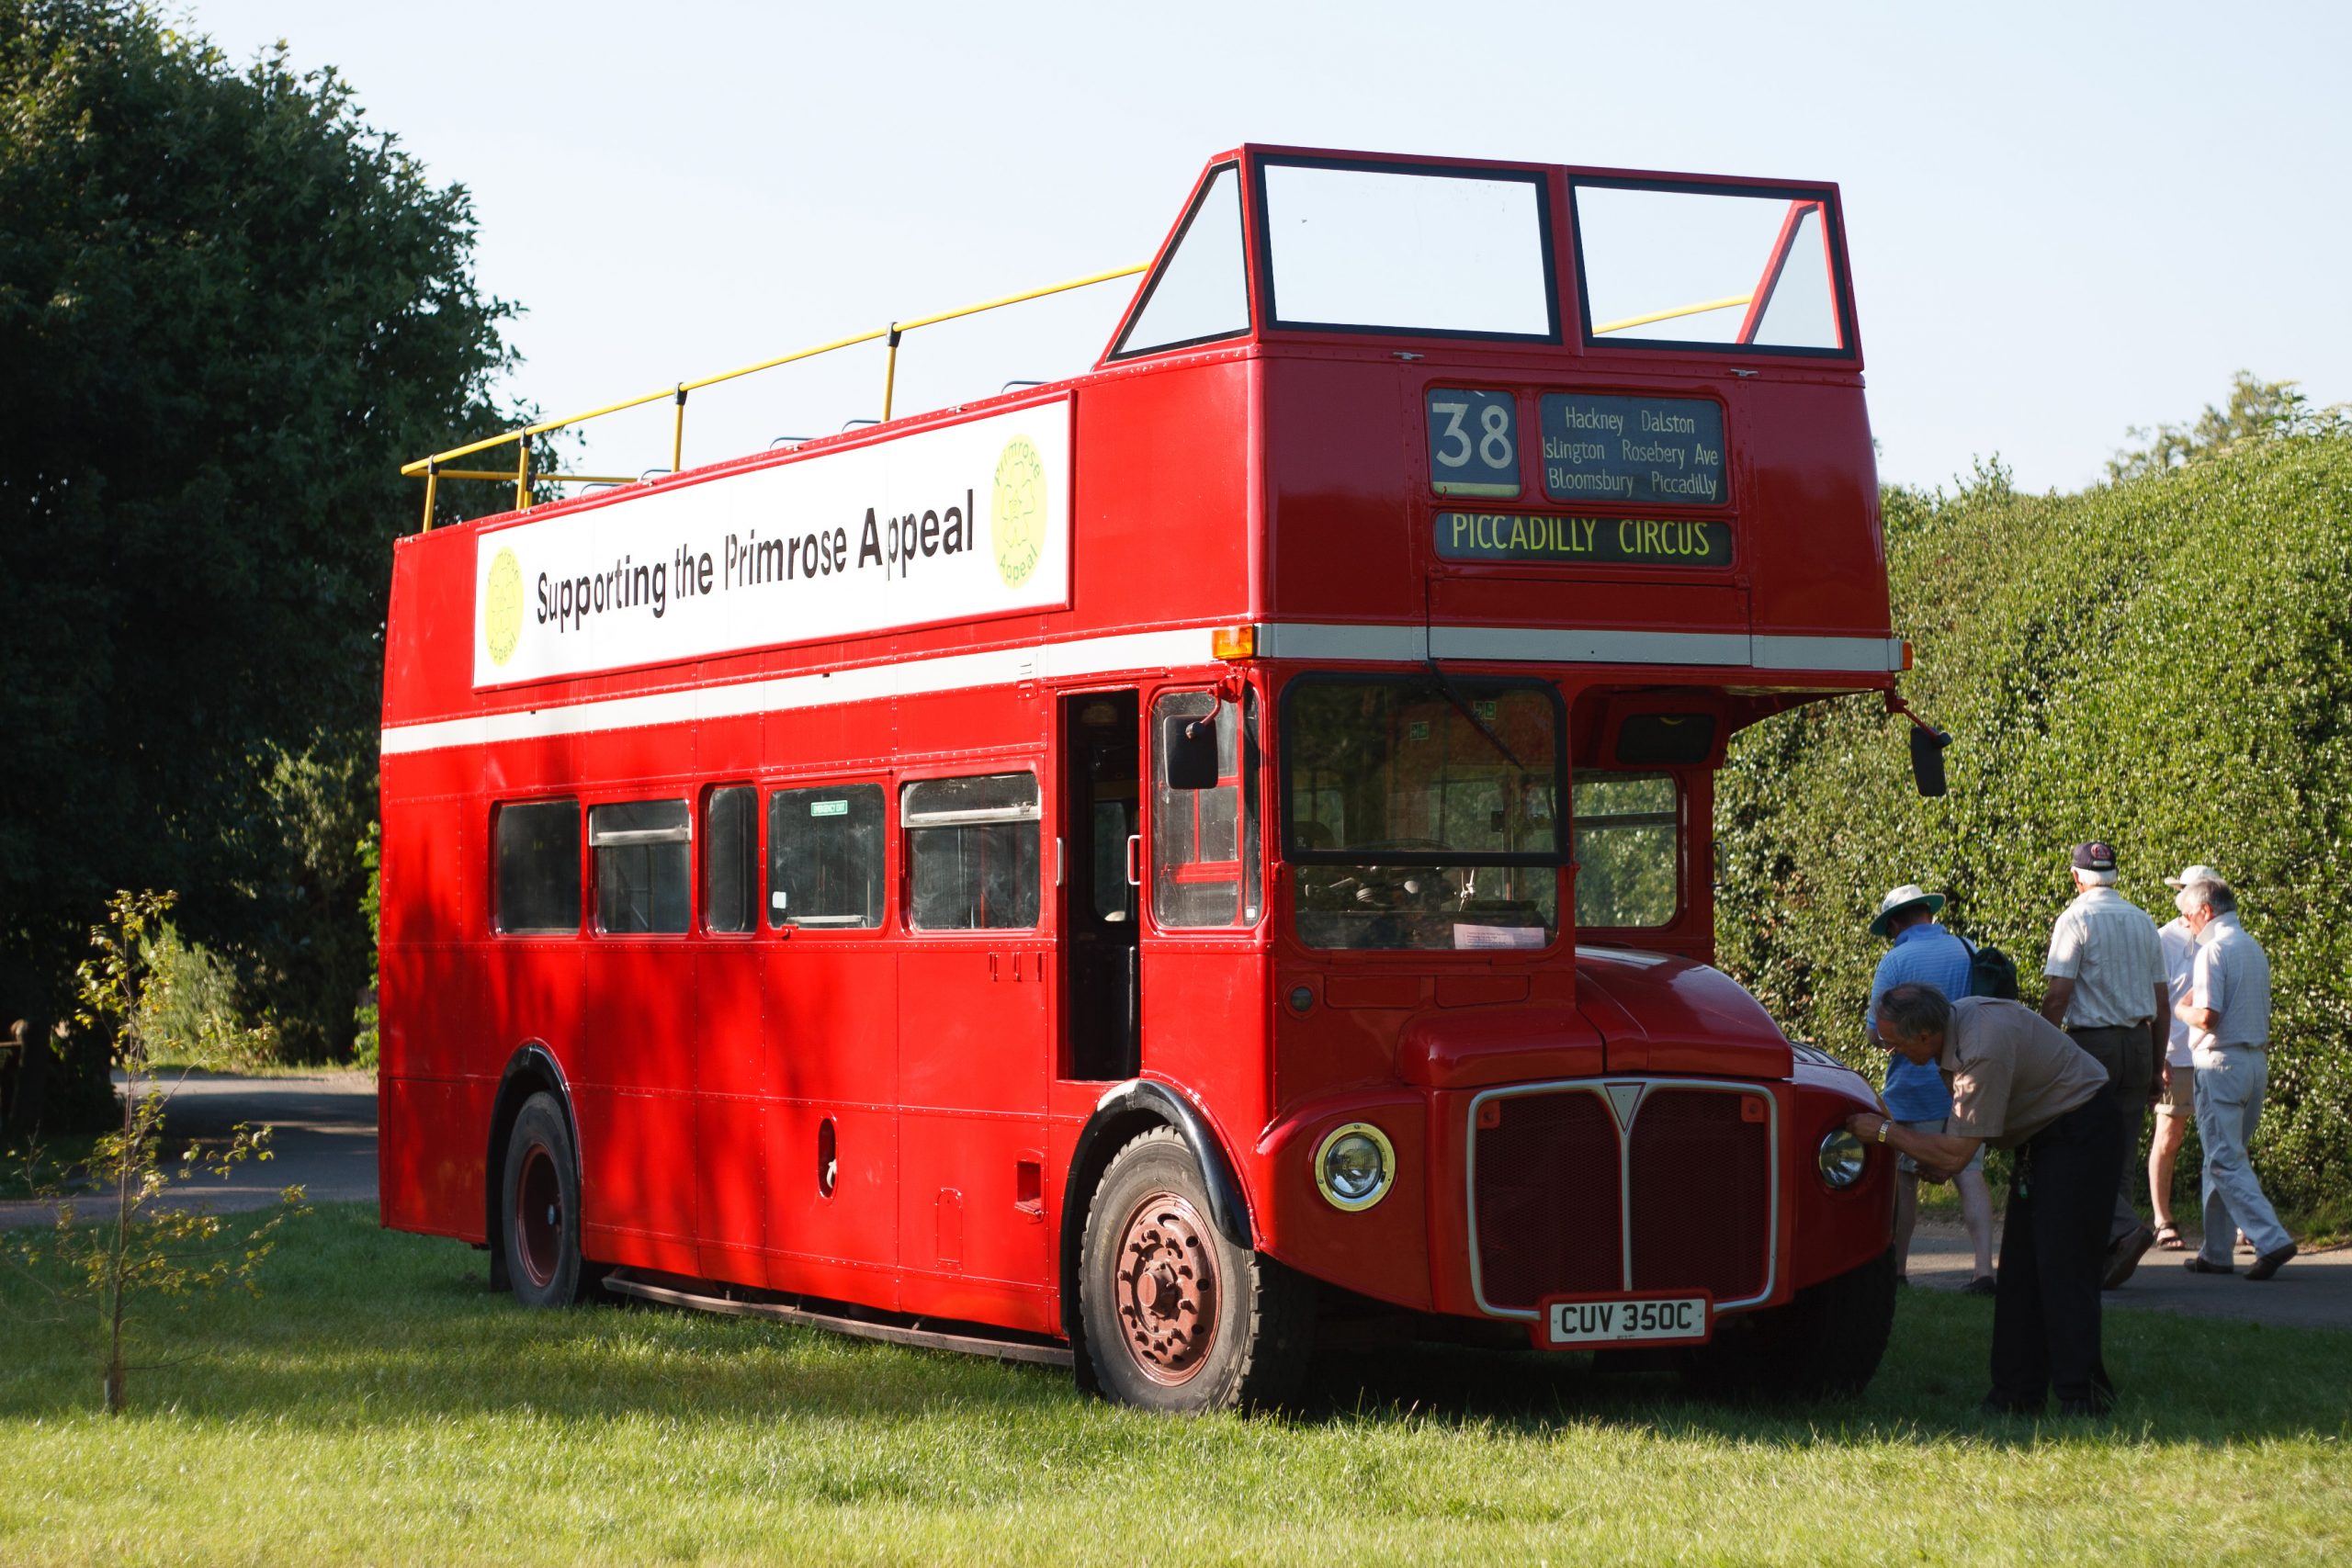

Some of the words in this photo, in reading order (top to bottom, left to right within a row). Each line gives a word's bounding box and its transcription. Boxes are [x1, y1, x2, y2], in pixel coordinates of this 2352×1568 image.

[1432, 402, 1513, 469] 38
[1566, 406, 1623, 436] Hackney
[1641, 410, 1695, 434] Dalston
[1622, 439, 1685, 469] Rosebery
[1695, 443, 1719, 466] Ave
[1549, 468, 1634, 497] Bloomsbury
[1652, 471, 1717, 501] Piccadilly
[1453, 513, 1598, 552] PICCADILLY
[1619, 519, 1710, 556] CIRCUS
[537, 555, 666, 633] Supporting
[673, 543, 714, 600] the
[725, 528, 847, 591] Primrose
[858, 489, 974, 581] Appeal
[1000, 543, 1039, 584] Appeal
[1562, 1305, 1613, 1334] CUV
[1623, 1303, 1692, 1331] 350C
